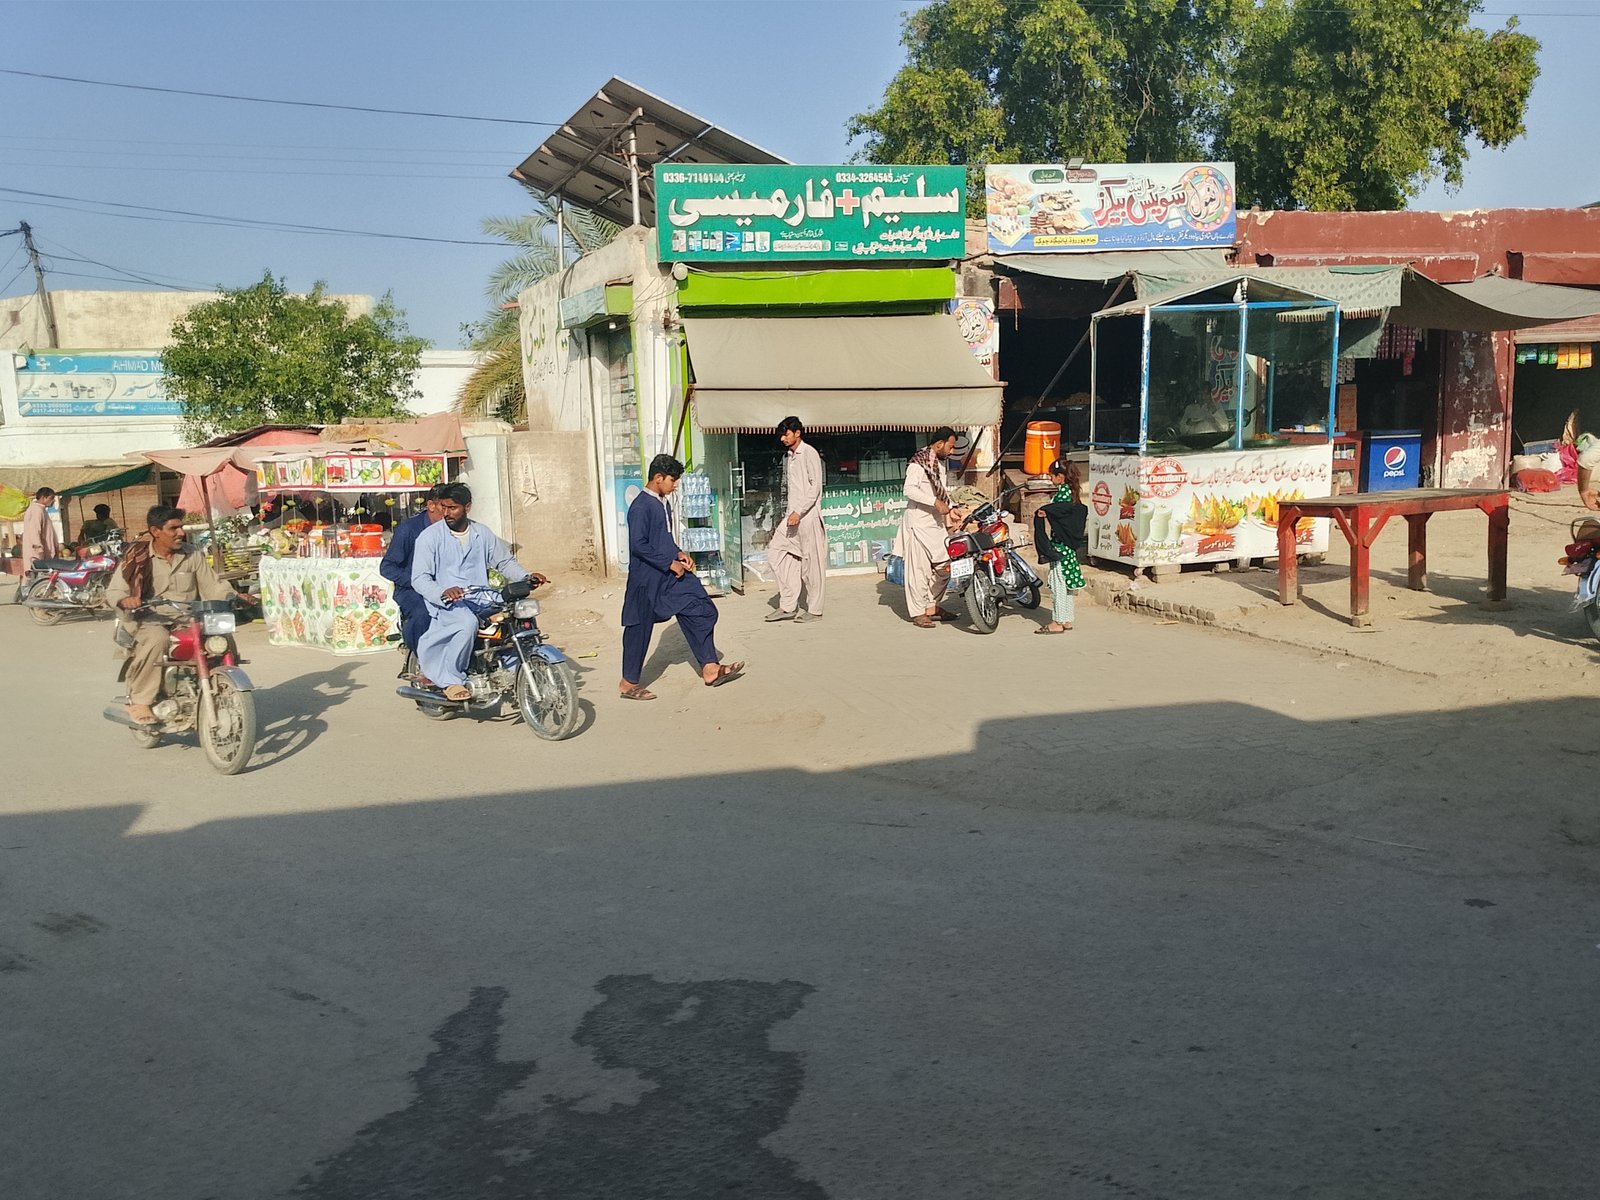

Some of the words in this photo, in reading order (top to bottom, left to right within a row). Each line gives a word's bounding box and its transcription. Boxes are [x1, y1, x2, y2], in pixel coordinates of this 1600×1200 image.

[668, 177, 834, 227] فارمیسی
[861, 175, 959, 228] سلیم
[112, 360, 149, 373] AHMAD
[151, 360, 165, 373] ME
[1384, 469, 1405, 478] pepsi
[863, 485, 904, 496] PHARM
